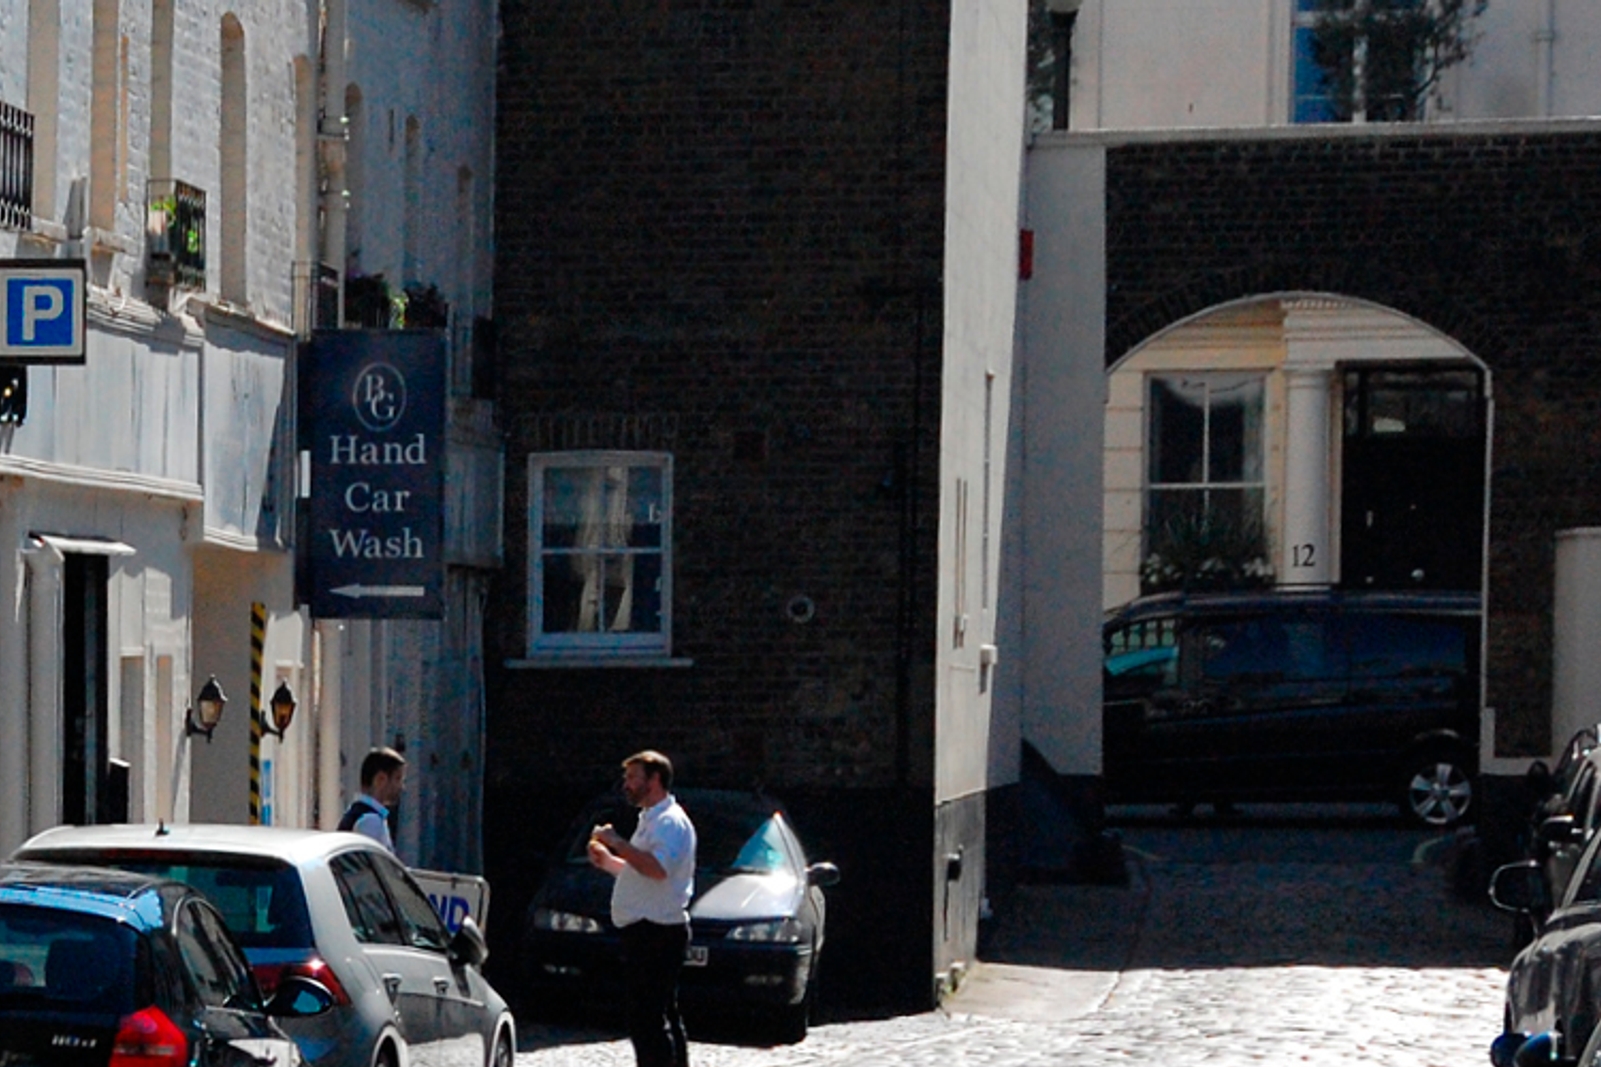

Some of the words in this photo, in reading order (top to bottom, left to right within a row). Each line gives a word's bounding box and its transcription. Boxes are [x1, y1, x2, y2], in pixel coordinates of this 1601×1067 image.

[22, 285, 64, 341] P
[329, 432, 427, 465] Hand
[344, 481, 410, 513] Car
[328, 527, 425, 559] Wash
[1292, 542, 1316, 568] 12
